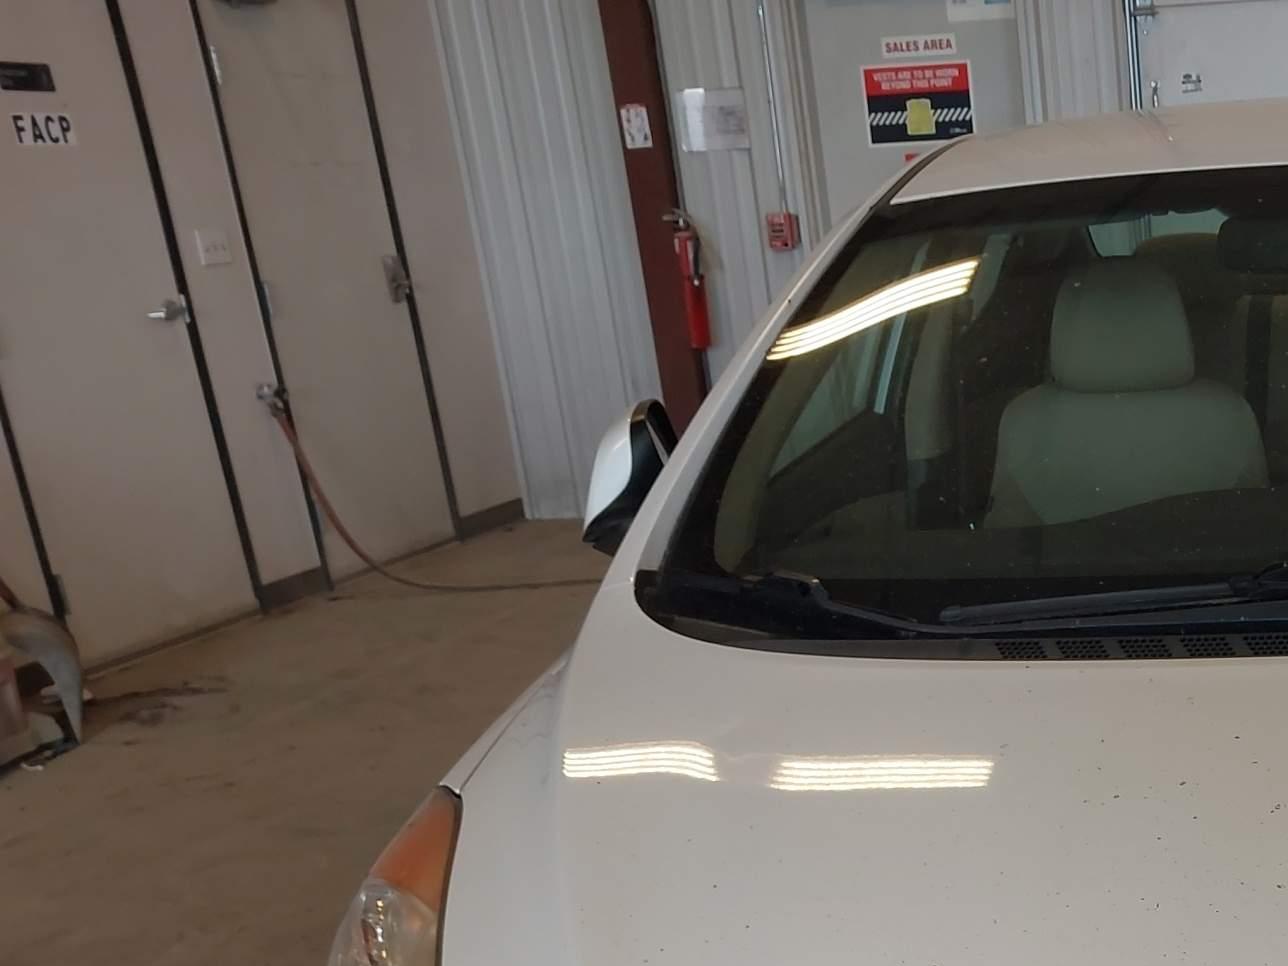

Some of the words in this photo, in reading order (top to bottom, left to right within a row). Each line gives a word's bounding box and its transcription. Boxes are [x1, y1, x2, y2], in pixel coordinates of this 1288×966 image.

[884, 40, 920, 54] SALES
[923, 38, 952, 50] AREA
[12, 114, 71, 144] FACP
